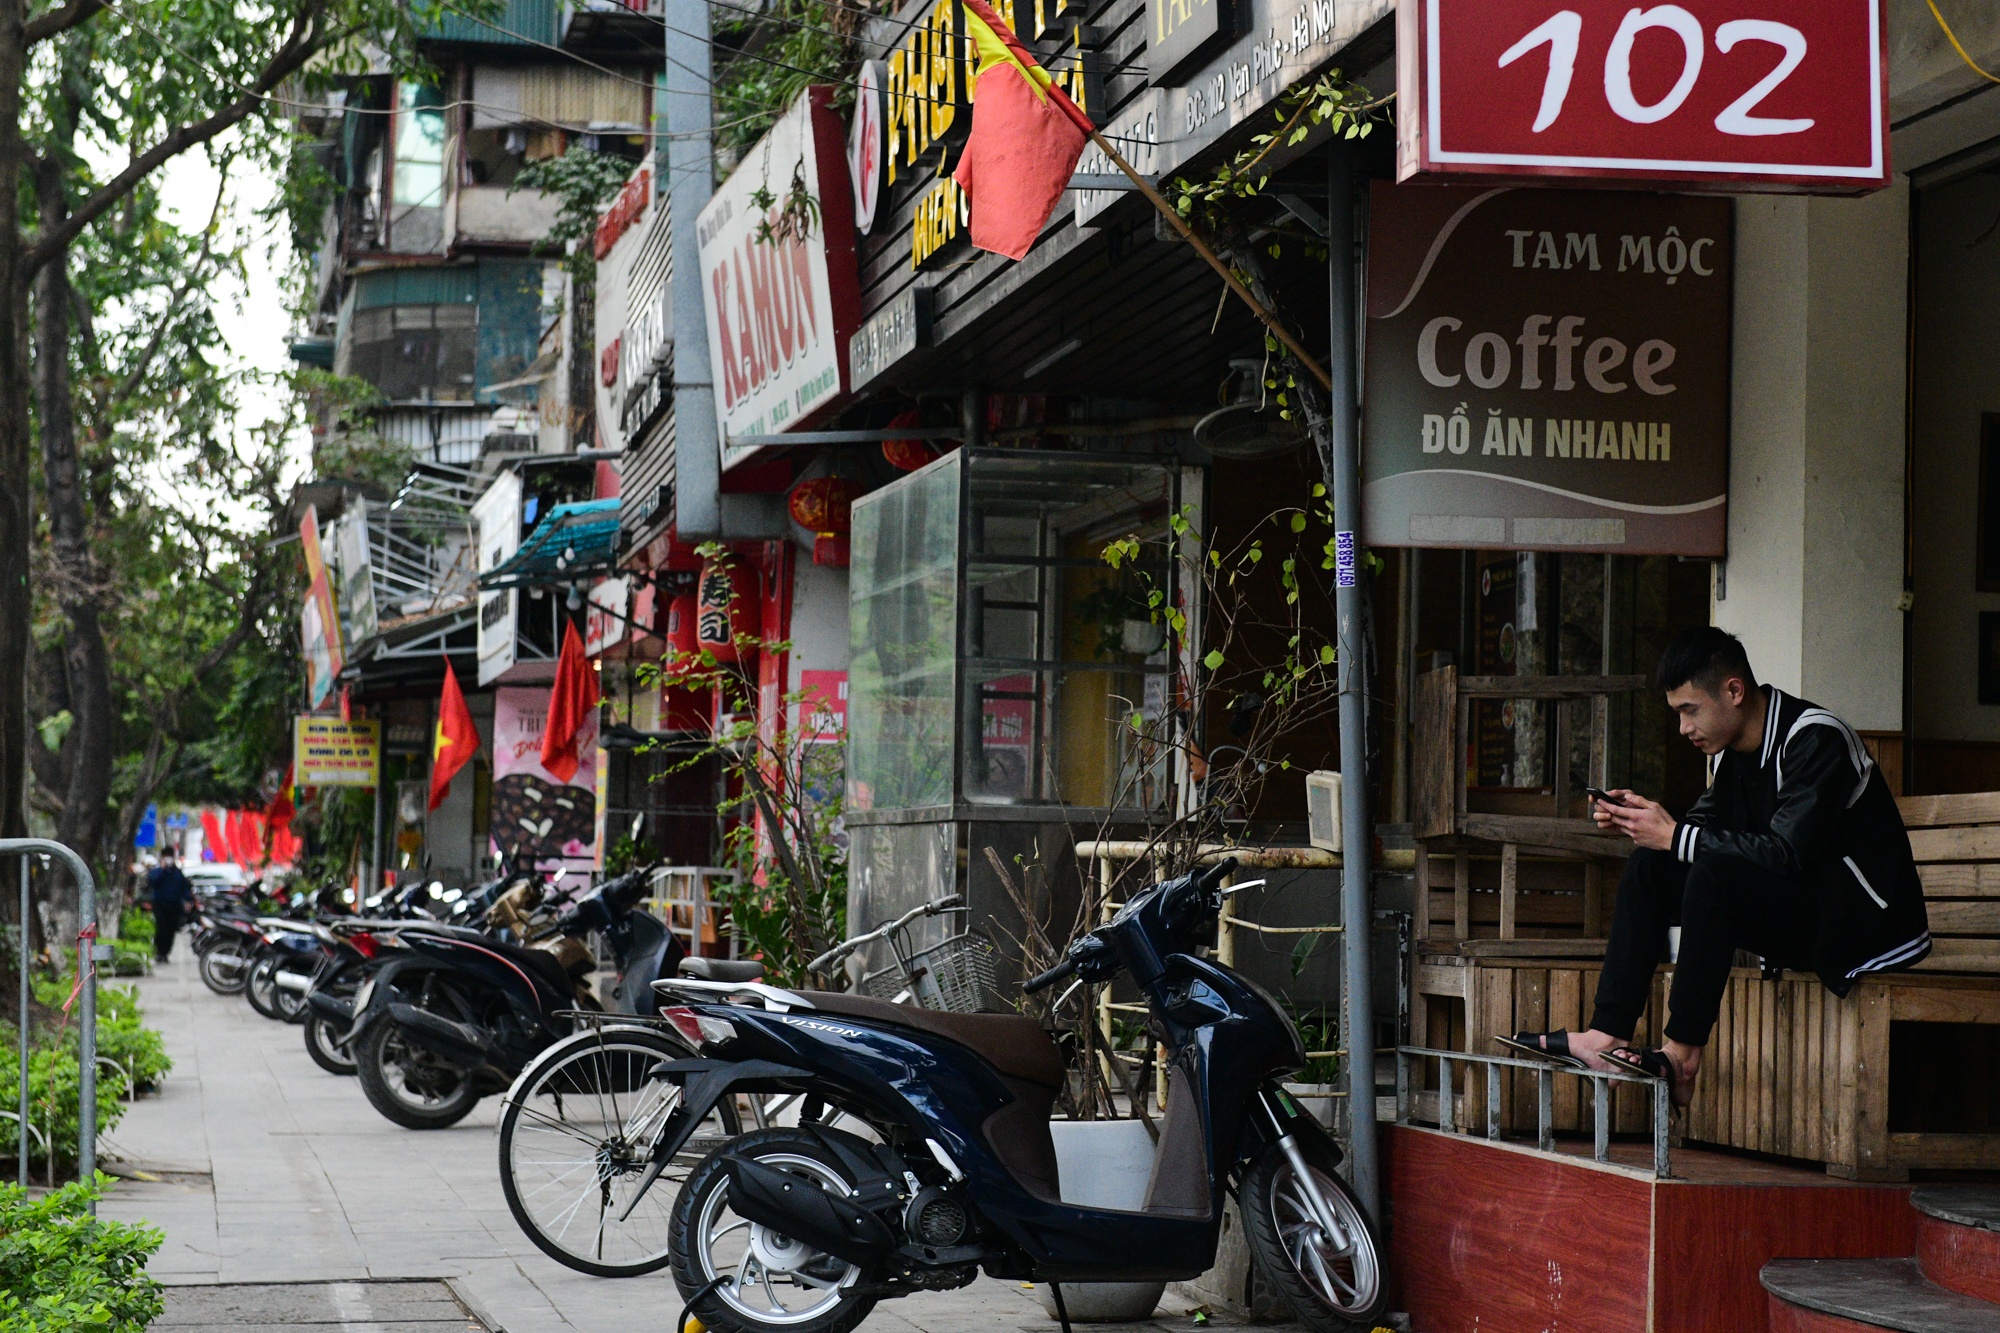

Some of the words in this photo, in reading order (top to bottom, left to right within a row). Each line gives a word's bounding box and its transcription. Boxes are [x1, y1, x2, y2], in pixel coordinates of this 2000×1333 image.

[1208, 73, 1226, 118] 102
[1228, 61, 1250, 107] Vạn
[1253, 28, 1283, 85] Phúc
[1291, 4, 1310, 56] Hà
[1498, 4, 1815, 136] 102
[1505, 229, 1602, 271] TAM
[1618, 226, 1714, 285] MỘC
[1416, 315, 1677, 396] Coffee
[1421, 402, 1471, 455] ĐỒ
[1482, 409, 1533, 458] ĂN
[1545, 419, 1671, 462] NHANH
[1338, 532, 1355, 586] 0971.458.854
[781, 1016, 863, 1038] VISION
